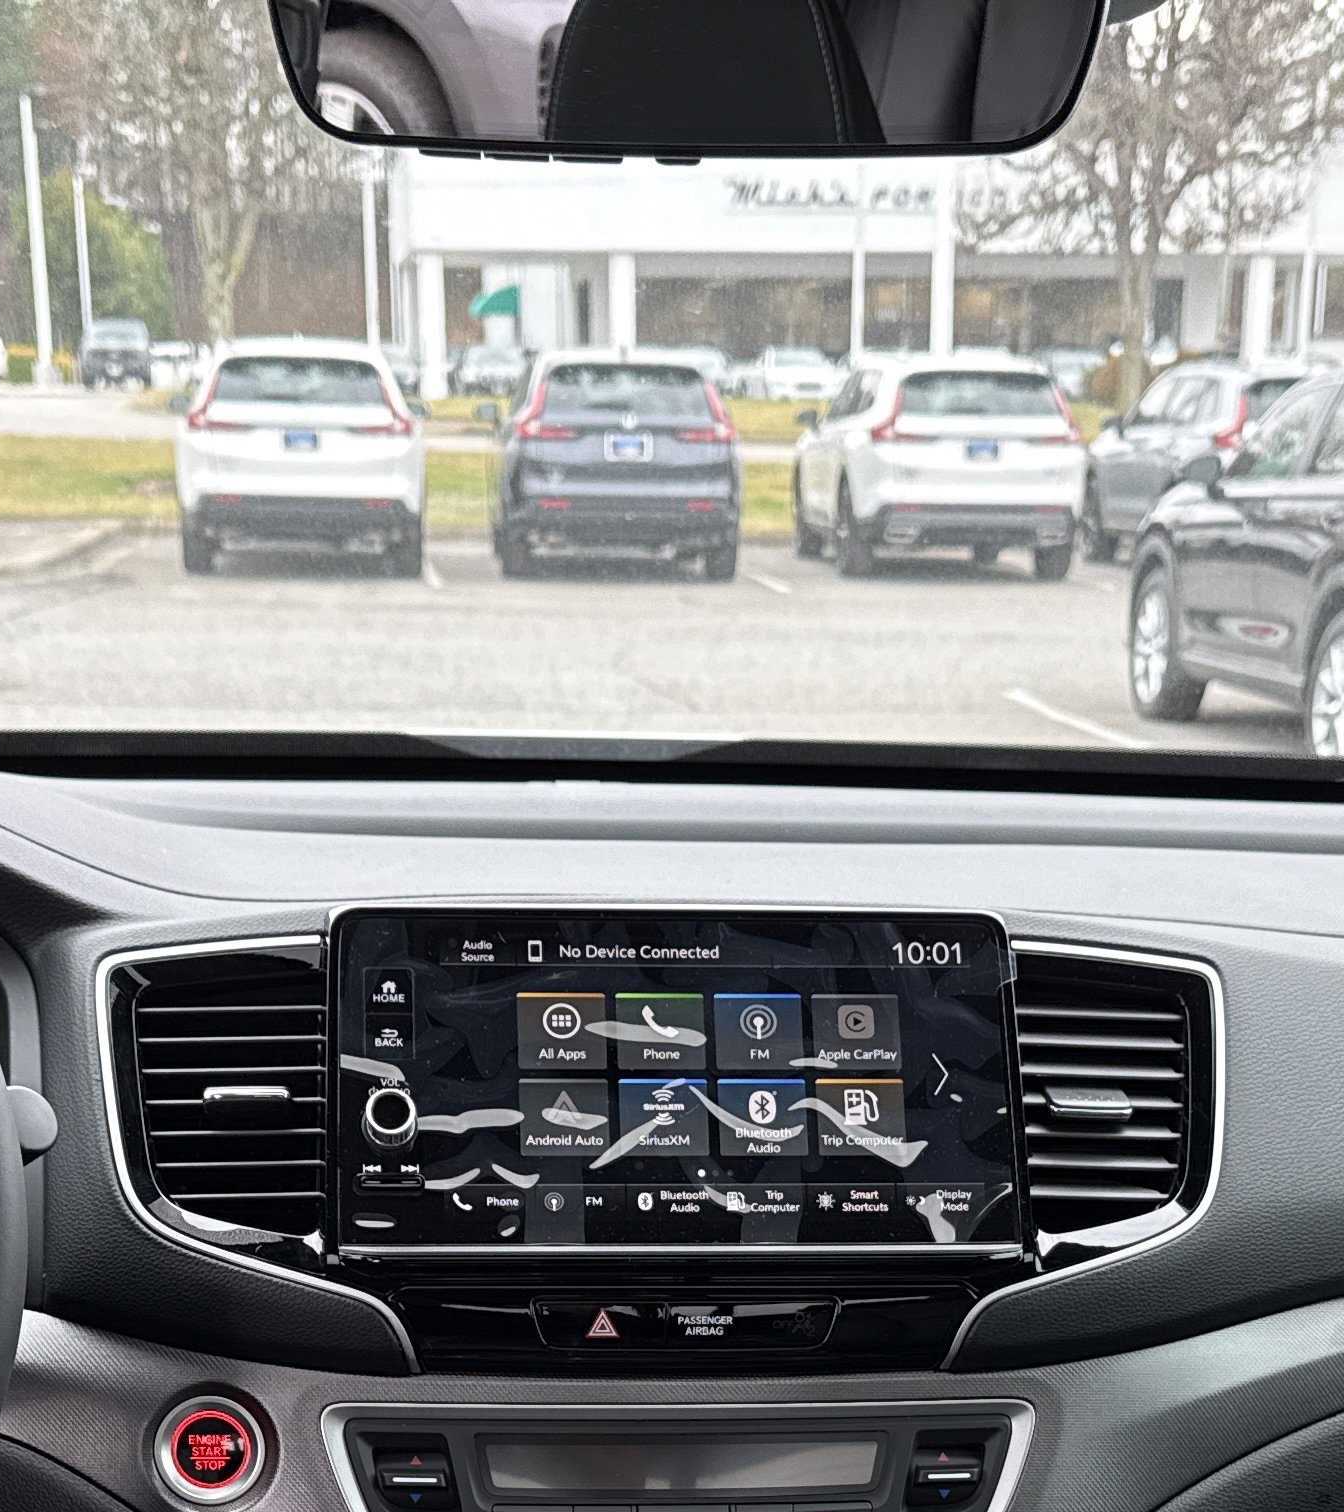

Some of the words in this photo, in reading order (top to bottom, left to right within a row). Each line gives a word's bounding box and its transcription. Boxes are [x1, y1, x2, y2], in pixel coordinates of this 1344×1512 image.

[463, 939, 493, 951] Audio
[559, 944, 581, 958] No
[585, 944, 636, 959] Device
[640, 944, 719, 959] Connected
[892, 941, 962, 965] 10:01
[460, 952, 495, 963] Source
[372, 993, 405, 1003] HOME
[374, 1037, 403, 1047] BACK
[538, 1049, 554, 1060] All
[557, 1049, 587, 1062] Apps
[643, 1049, 681, 1061] Phone
[750, 1049, 770, 1060] FM
[818, 1049, 851, 1063] Apple
[853, 1049, 897, 1062] CarPlay
[379, 1077, 400, 1087] VOL
[735, 1127, 792, 1138] Bluetooth
[526, 1135, 572, 1146] Android
[575, 1135, 603, 1146] Auto
[639, 1134, 690, 1146] SiriusXM
[821, 1135, 844, 1148] Trip
[846, 1135, 904, 1148] Computer
[746, 1142, 781, 1153] Audio
[659, 1190, 708, 1200] Bluetooth
[765, 1189, 784, 1201] Trip
[850, 1189, 879, 1200] Smart
[936, 1189, 972, 1201] Display
[486, 1195, 520, 1207] Phone
[585, 1196, 603, 1206] FM
[669, 1202, 700, 1213] Audio
[751, 1202, 801, 1214] Computer
[842, 1202, 889, 1212] Shortcuts
[940, 1202, 969, 1212] Mode
[677, 1315, 733, 1325] PASSENGER
[685, 1326, 724, 1336] AIRBAG
[188, 1434, 232, 1446] ENGINE
[192, 1446, 228, 1457] START
[195, 1460, 226, 1471] STOP
